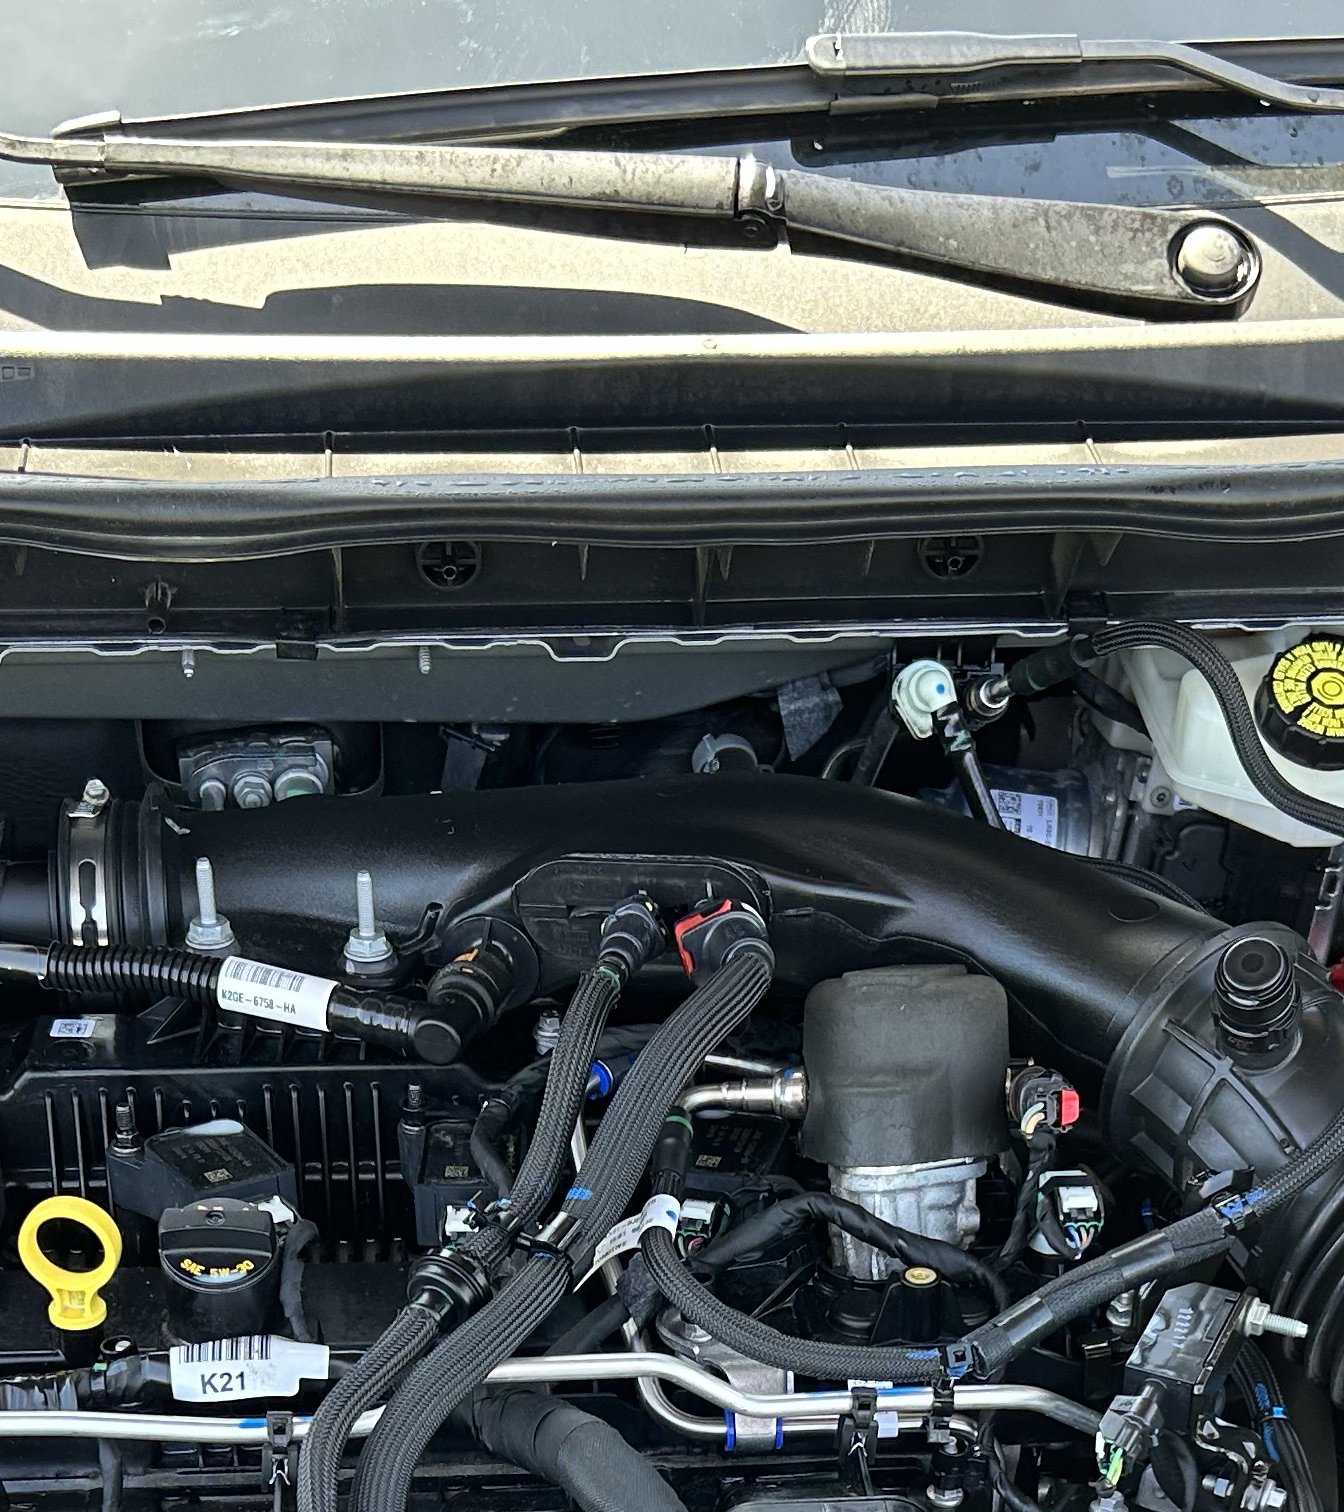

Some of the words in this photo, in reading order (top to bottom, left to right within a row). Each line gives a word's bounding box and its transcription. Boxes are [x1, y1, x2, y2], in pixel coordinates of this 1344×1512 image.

[180, 1257, 205, 1277] SAE
[209, 1259, 255, 1277] 5W-30
[200, 1371, 246, 1395] K21
